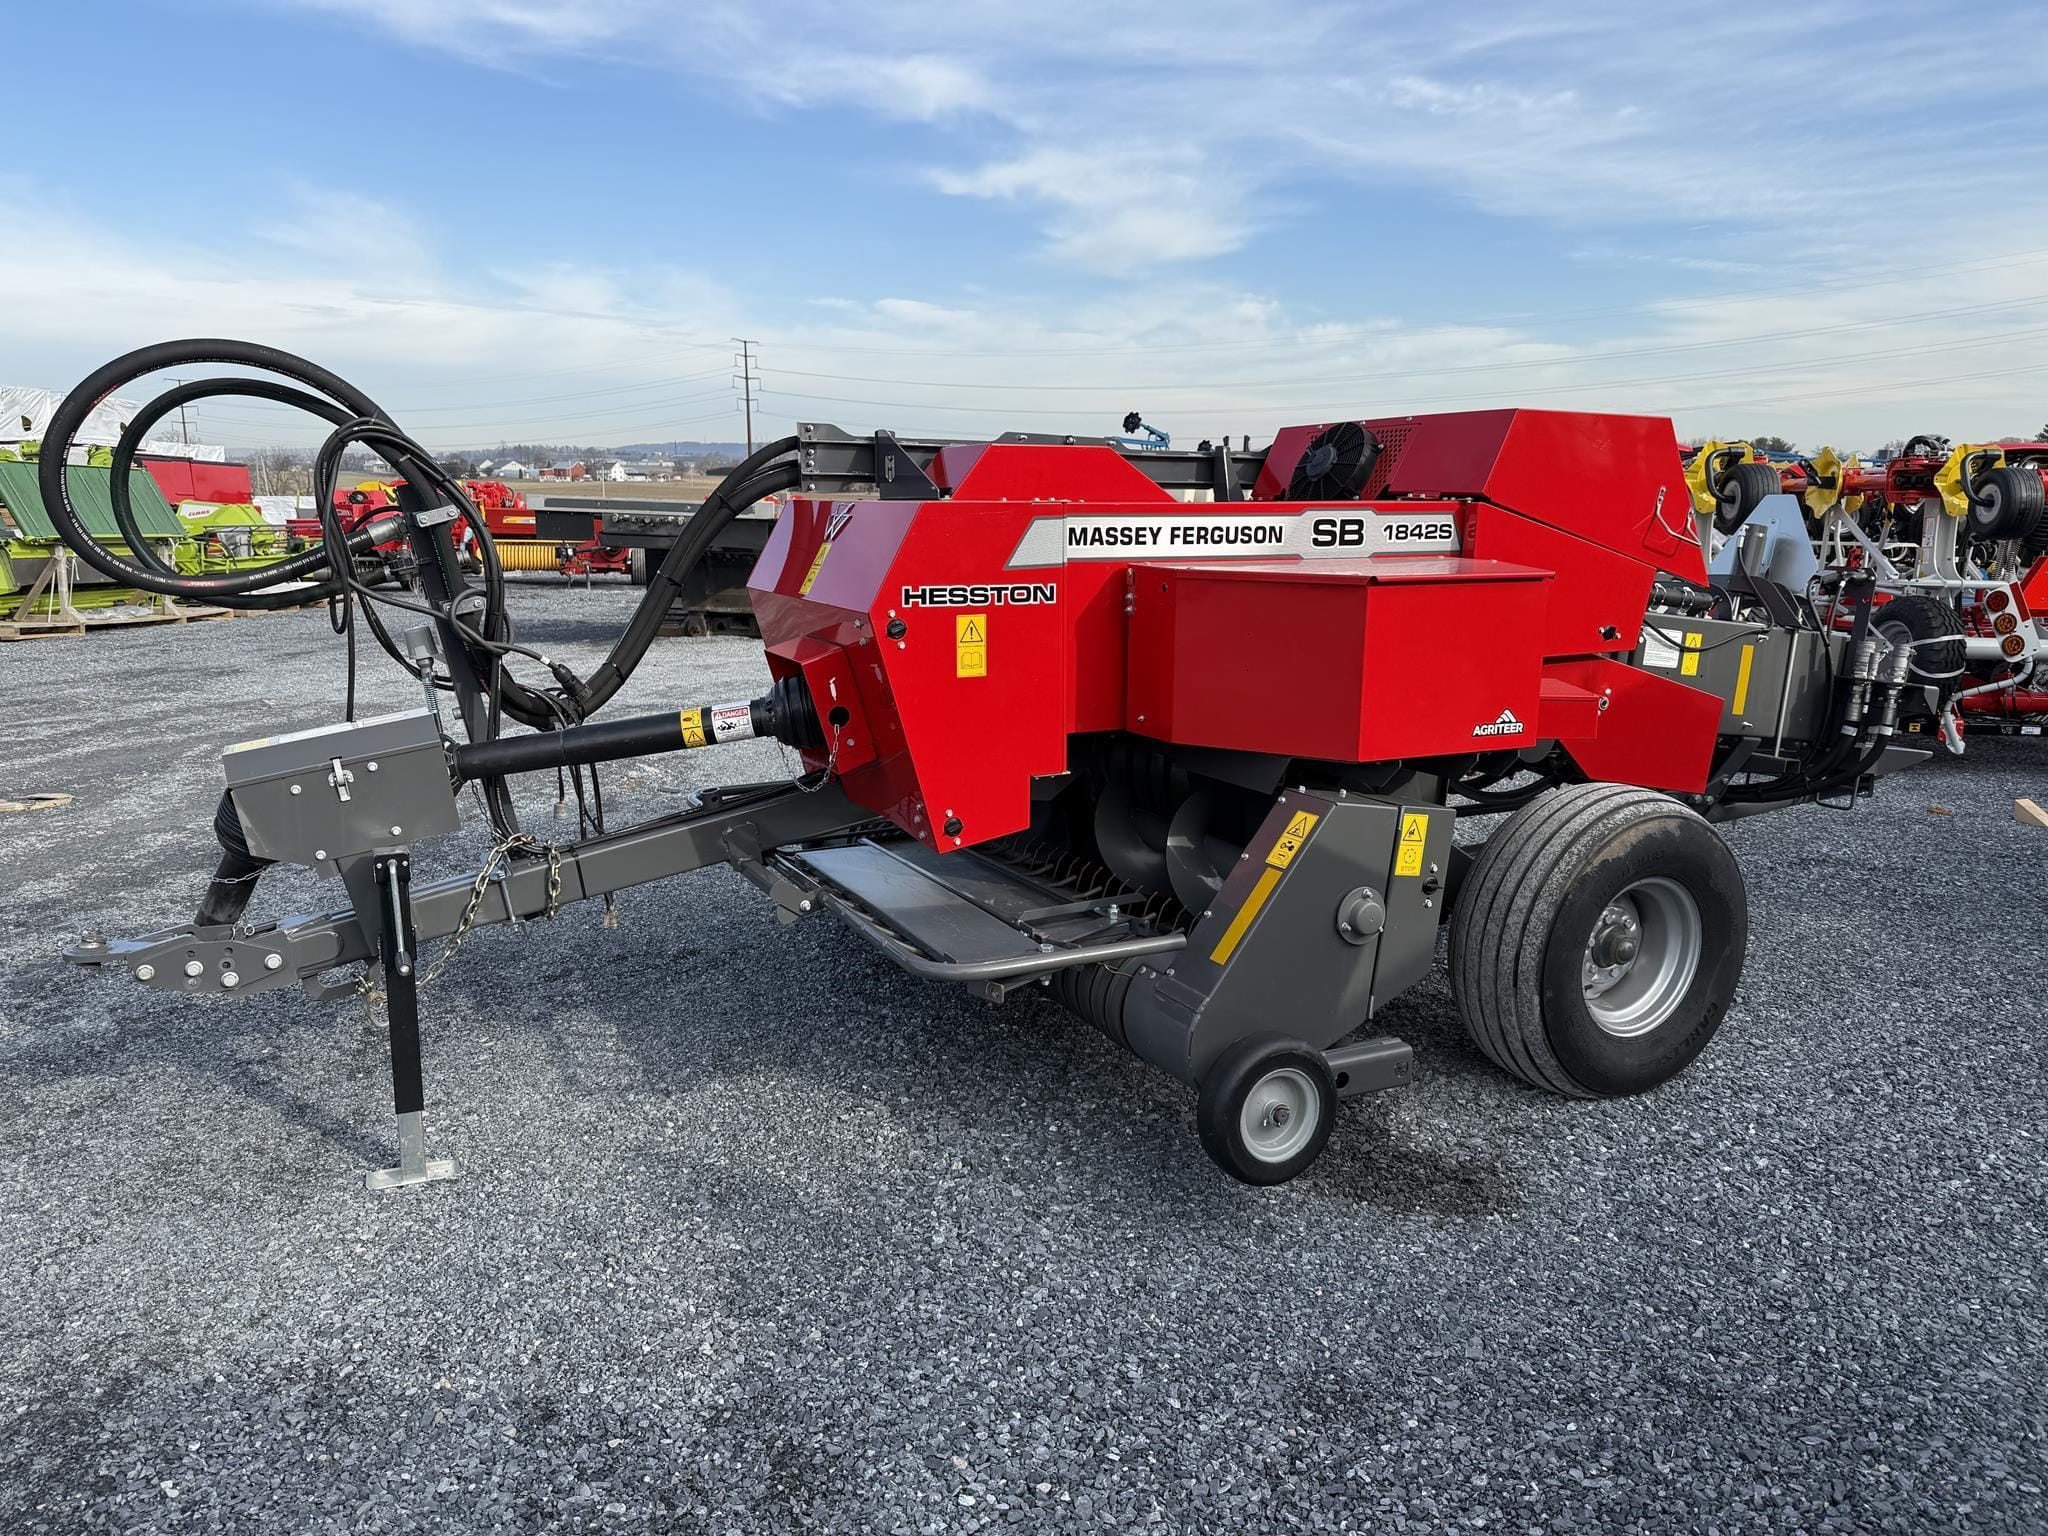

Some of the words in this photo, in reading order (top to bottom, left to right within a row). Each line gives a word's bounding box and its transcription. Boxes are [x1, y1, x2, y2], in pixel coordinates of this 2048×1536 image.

[1068, 526, 1163, 546] MASSEY
[1170, 525, 1283, 545] FERGUSON
[1311, 518, 1365, 547] SB
[1383, 523, 1453, 541] 1842S
[903, 583, 1056, 606] HESSTON
[722, 708, 748, 719] DANGER
[1472, 722, 1524, 737] AGRITEER
